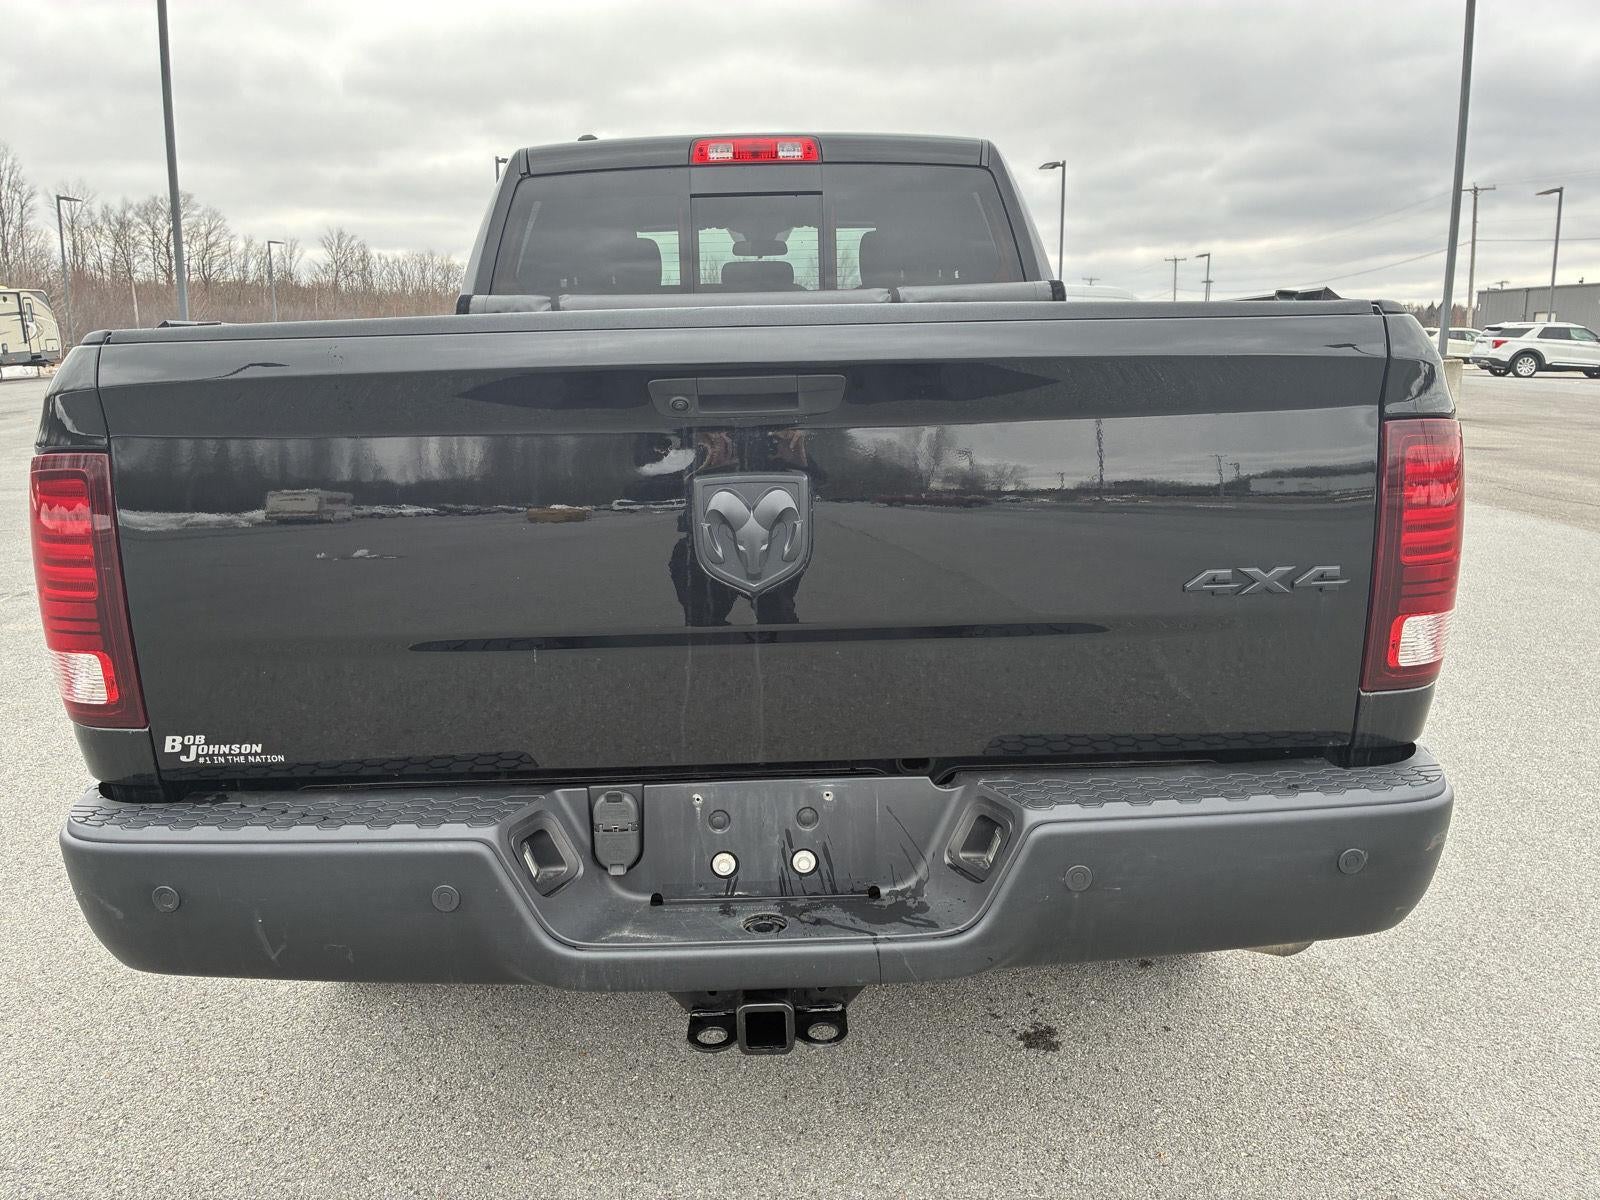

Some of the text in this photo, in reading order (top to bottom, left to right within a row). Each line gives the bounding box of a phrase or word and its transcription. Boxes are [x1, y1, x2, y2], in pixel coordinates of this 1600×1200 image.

[1183, 565, 1351, 596] 4X4
[164, 735, 205, 752] BOB
[180, 744, 262, 762] JOHNSON
[198, 756, 211, 764] #1
[248, 755, 285, 763] NATION
